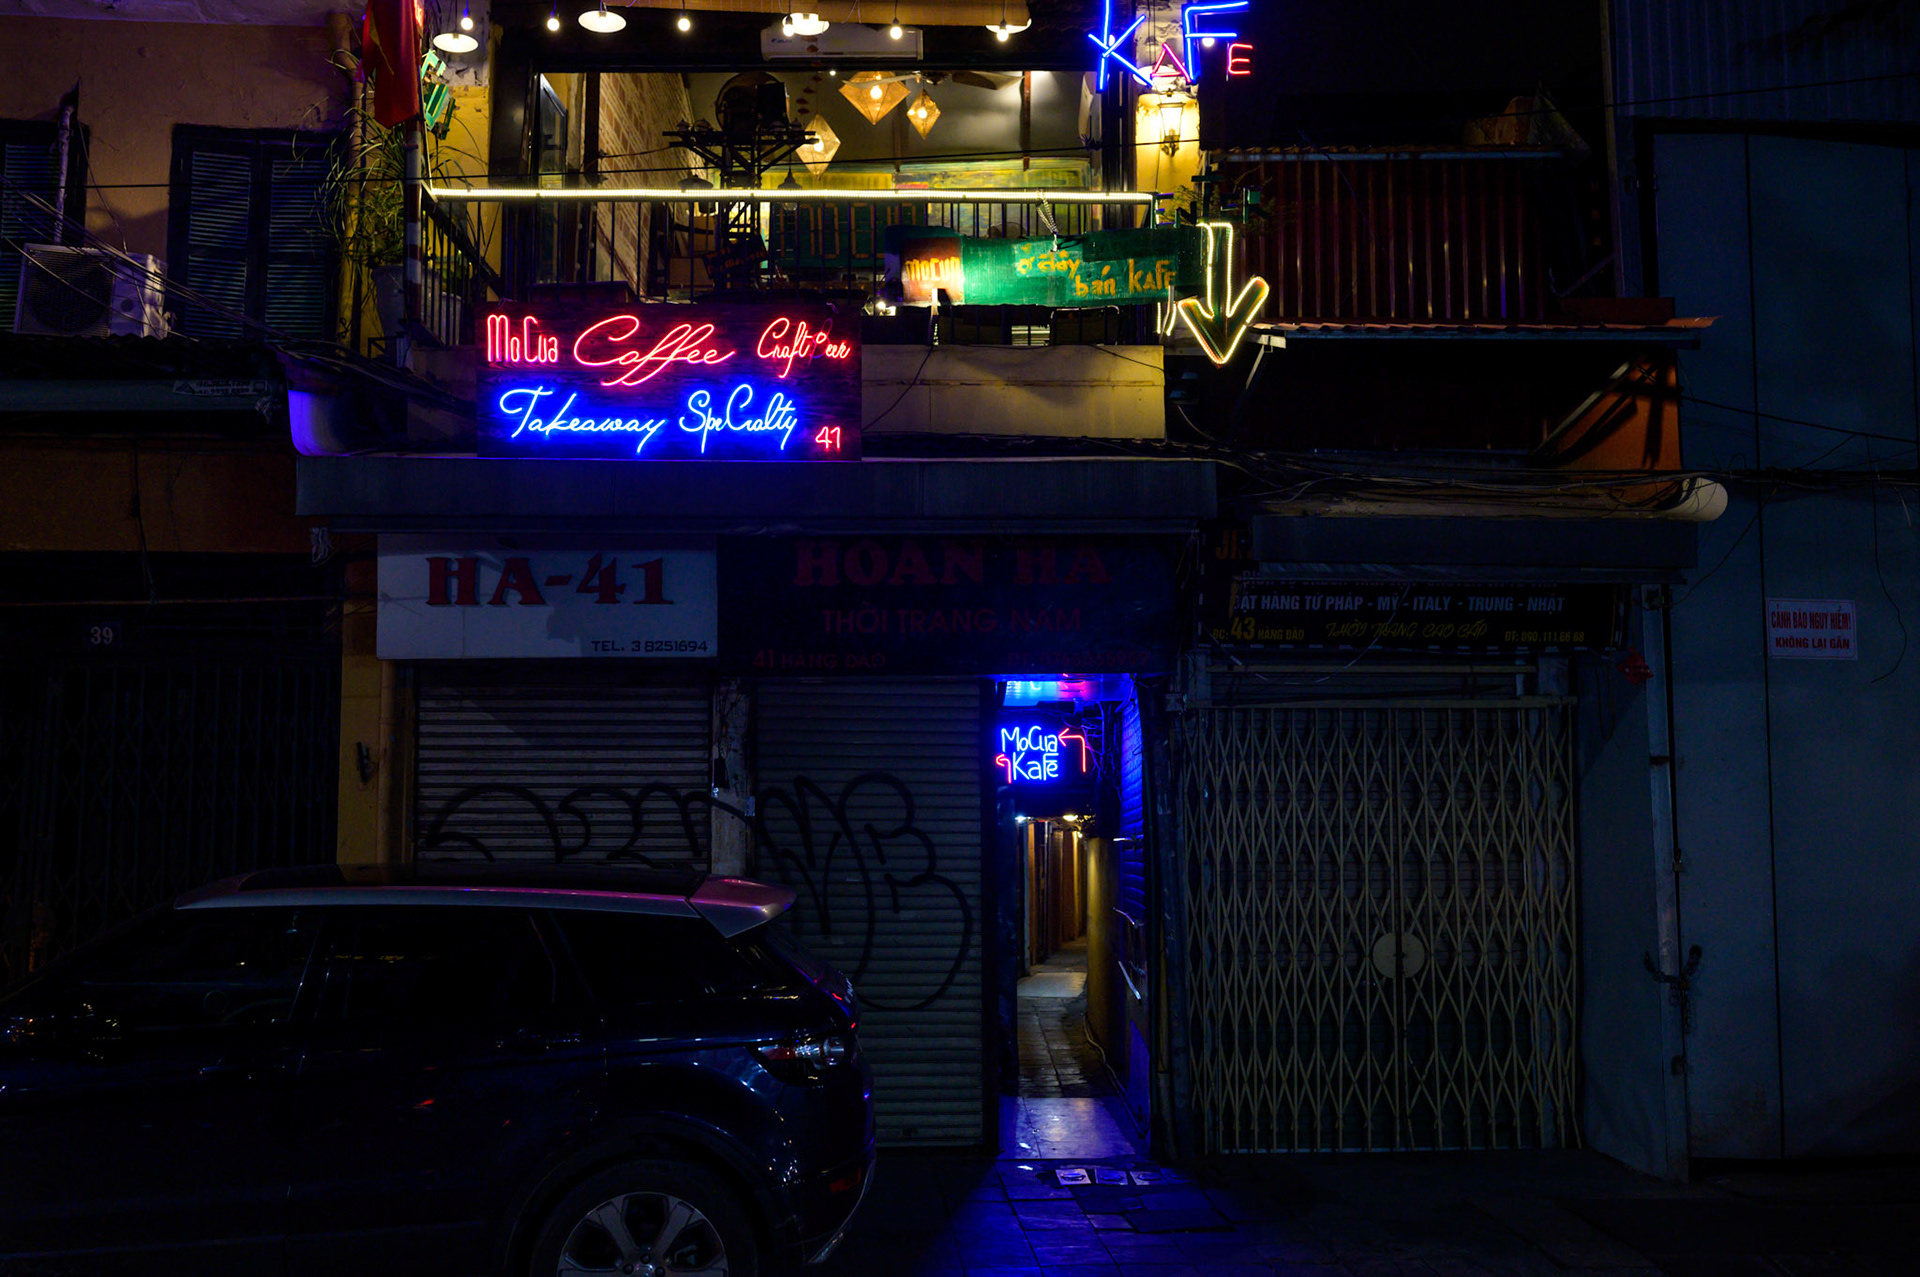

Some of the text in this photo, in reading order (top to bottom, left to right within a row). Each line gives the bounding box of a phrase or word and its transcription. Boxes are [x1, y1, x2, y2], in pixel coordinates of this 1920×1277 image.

[573, 314, 736, 387] Coffee
[757, 317, 813, 378] Craft
[499, 385, 667, 453] Takeaway
[815, 426, 841, 450] 41
[425, 552, 675, 606] HA-41
[1260, 590, 1301, 611] HÀNG
[1325, 591, 1363, 611] PHÁP
[1413, 595, 1451, 611] ITALY
[1467, 595, 1514, 612] TRUNG
[821, 600, 1082, 634] THỜI TRANG NAM
[90, 625, 114, 646] 39
[1230, 616, 1256, 641] 43
[1257, 625, 1283, 640] HÀNG
[1422, 622, 1455, 638] CAO
[591, 640, 625, 652] TEL.
[1775, 635, 1809, 649] KHÔNG
[752, 648, 775, 669] 41
